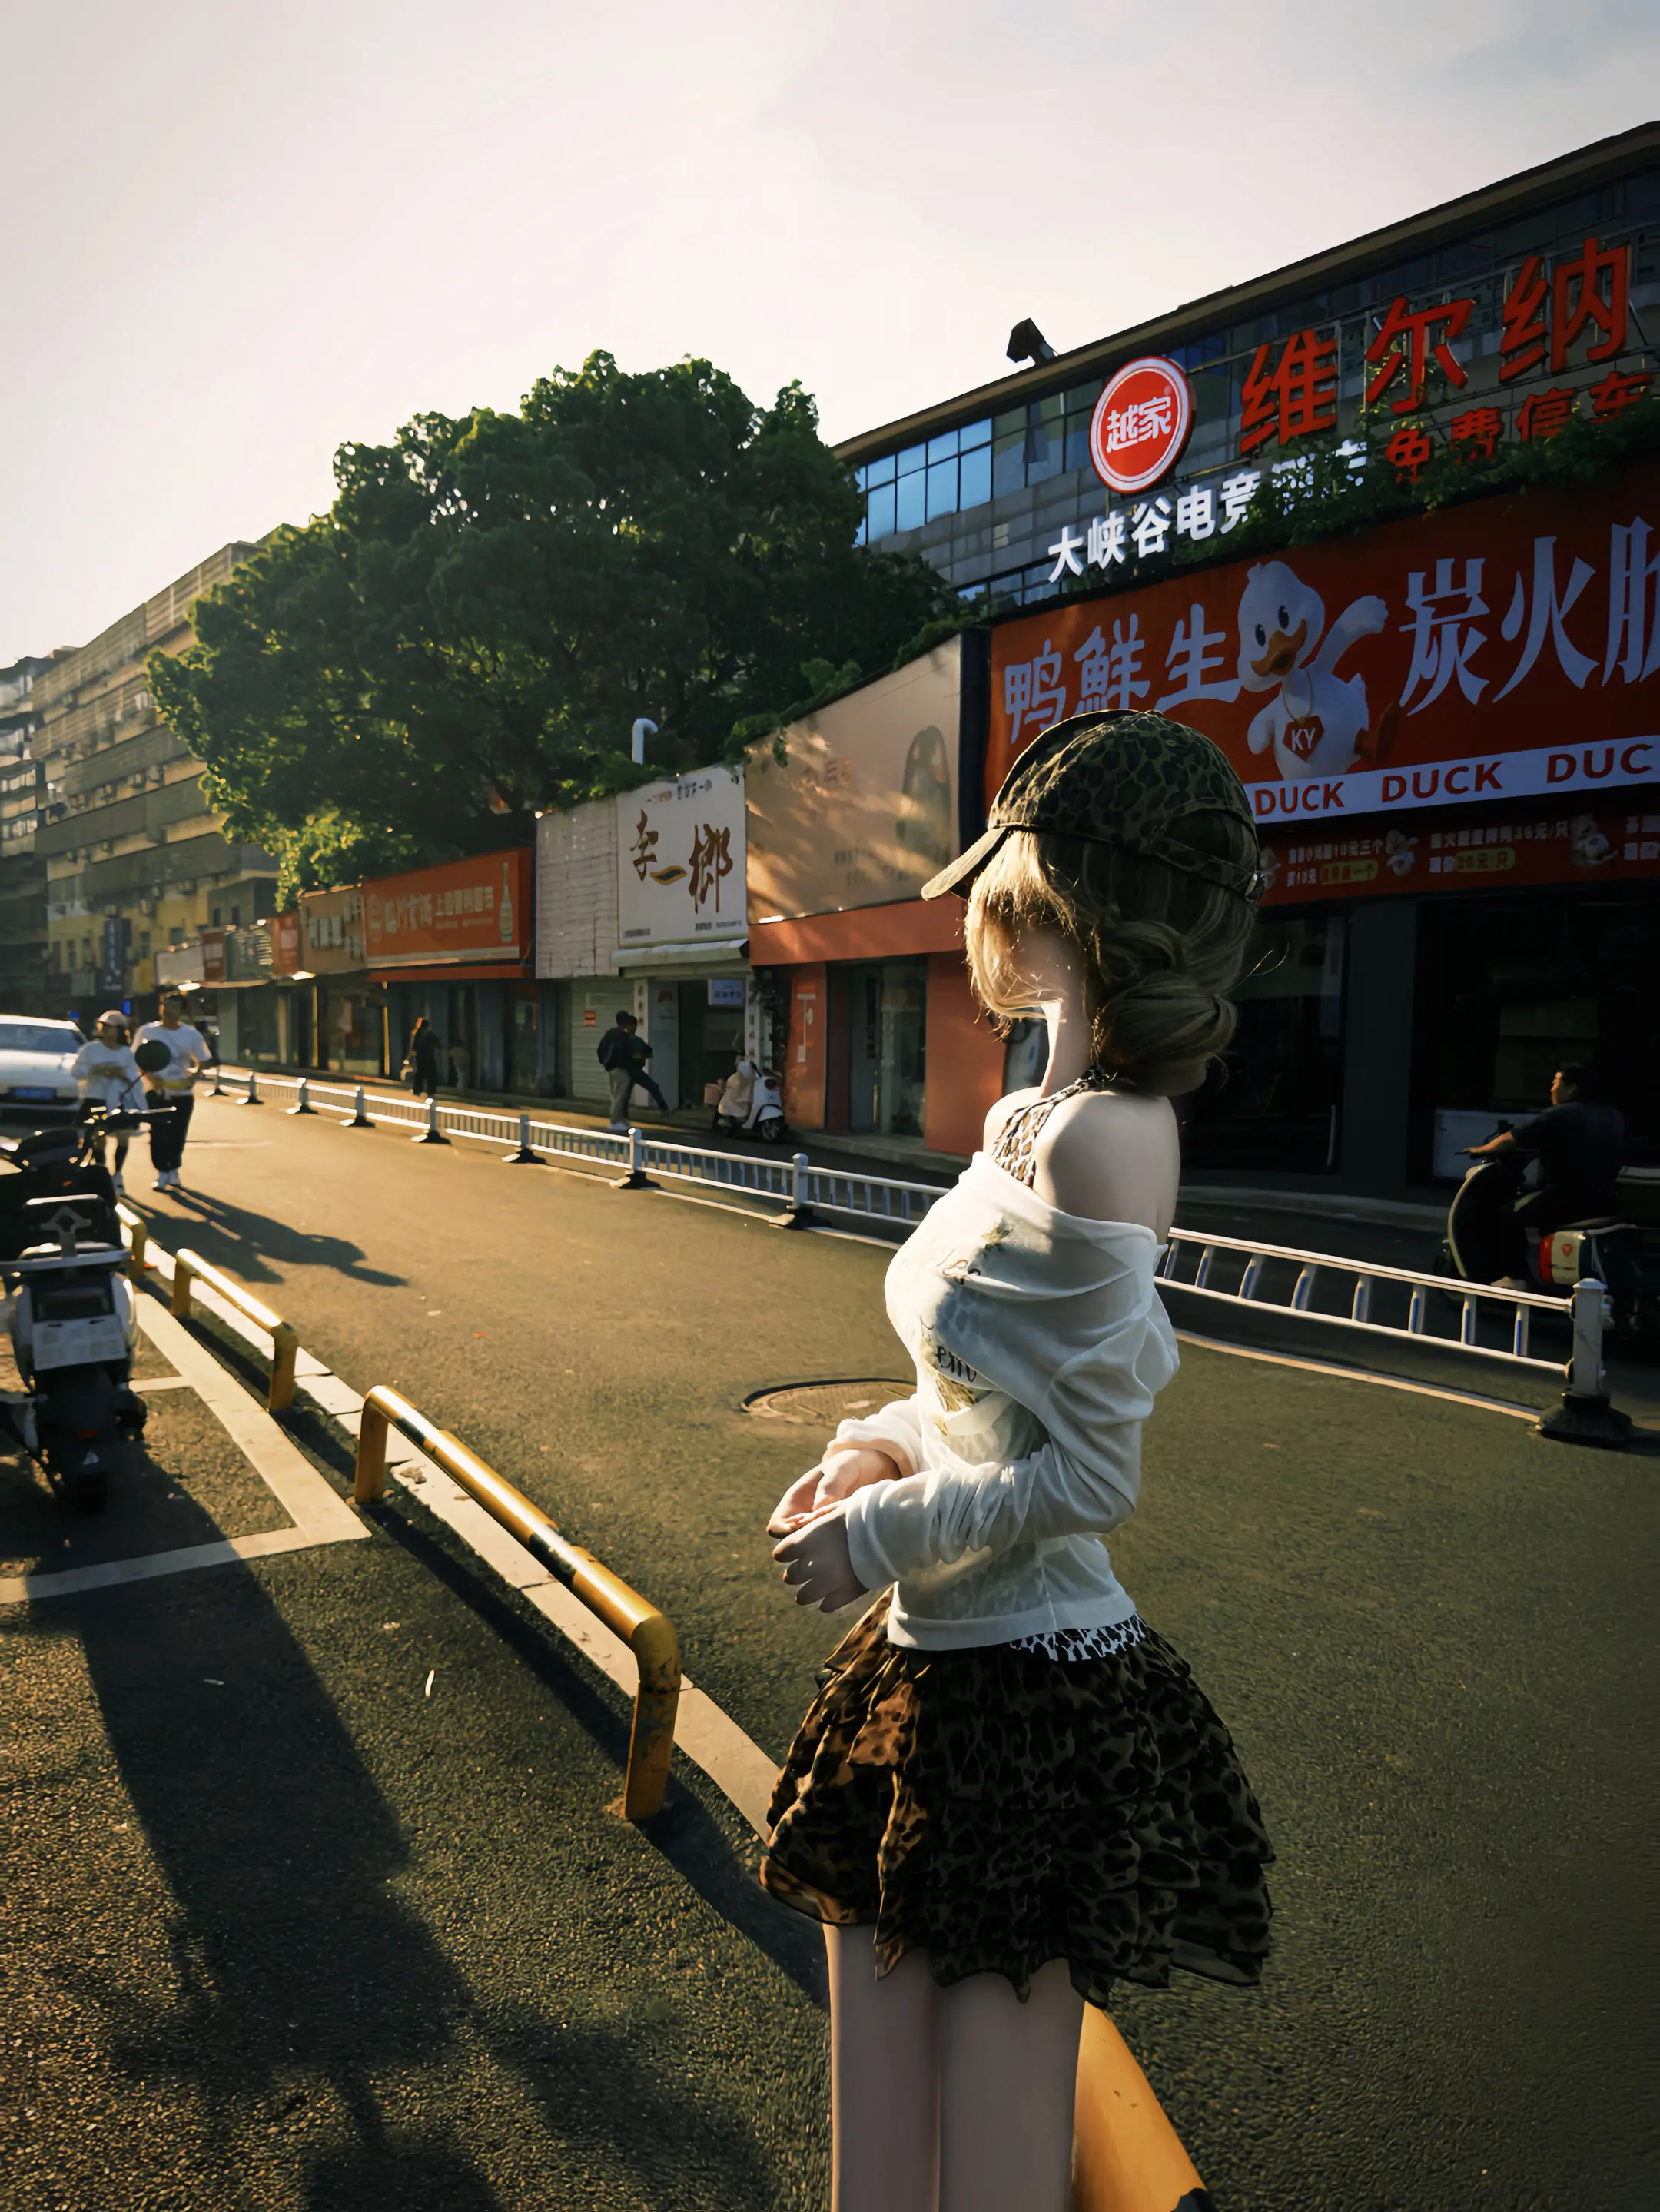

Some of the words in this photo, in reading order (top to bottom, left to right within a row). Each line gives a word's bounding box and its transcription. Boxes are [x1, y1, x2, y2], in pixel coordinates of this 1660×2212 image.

[1240, 237, 1631, 453] 维尔纳
[1106, 396, 1171, 453] 越家
[1291, 726, 1316, 752] KY
[1255, 782, 1345, 816] DUCK
[1382, 761, 1502, 802] DUCK
[1547, 743, 1652, 784] DUC
